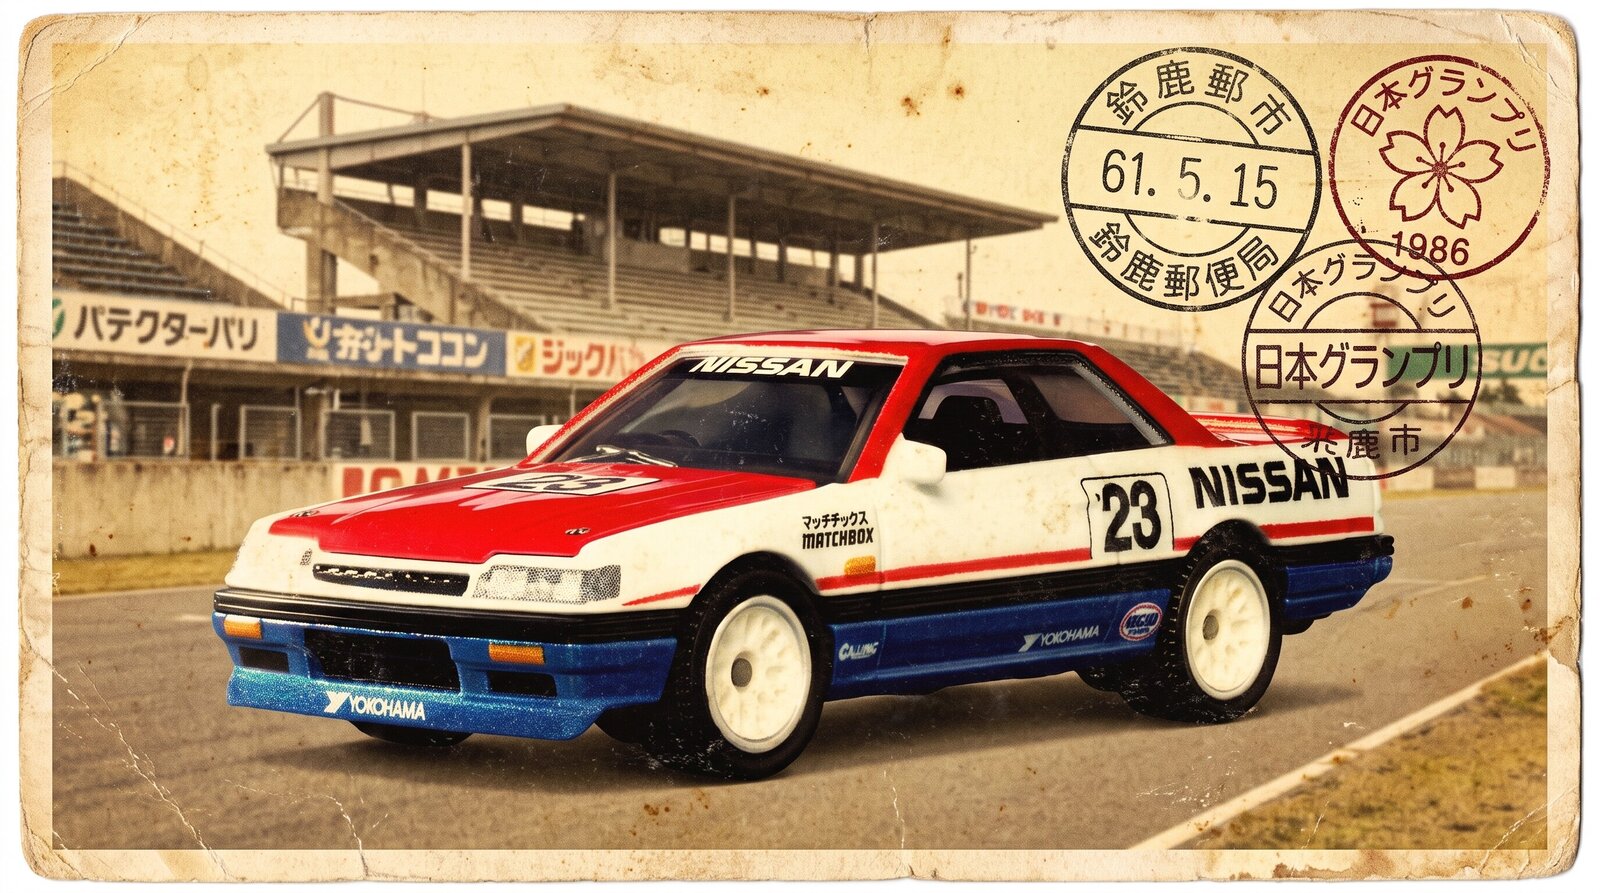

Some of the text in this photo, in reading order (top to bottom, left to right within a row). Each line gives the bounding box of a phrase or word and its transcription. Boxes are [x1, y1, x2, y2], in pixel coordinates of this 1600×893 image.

[689, 356, 855, 379] NISSAN
[491, 474, 627, 491] 23
[1188, 456, 1350, 509] NISSAN
[802, 511, 869, 530] マッチチックス
[802, 527, 874, 550] MATCHBOX
[1041, 625, 1099, 647] YOKOHAMA
[349, 695, 426, 721] YOKOHAMA
